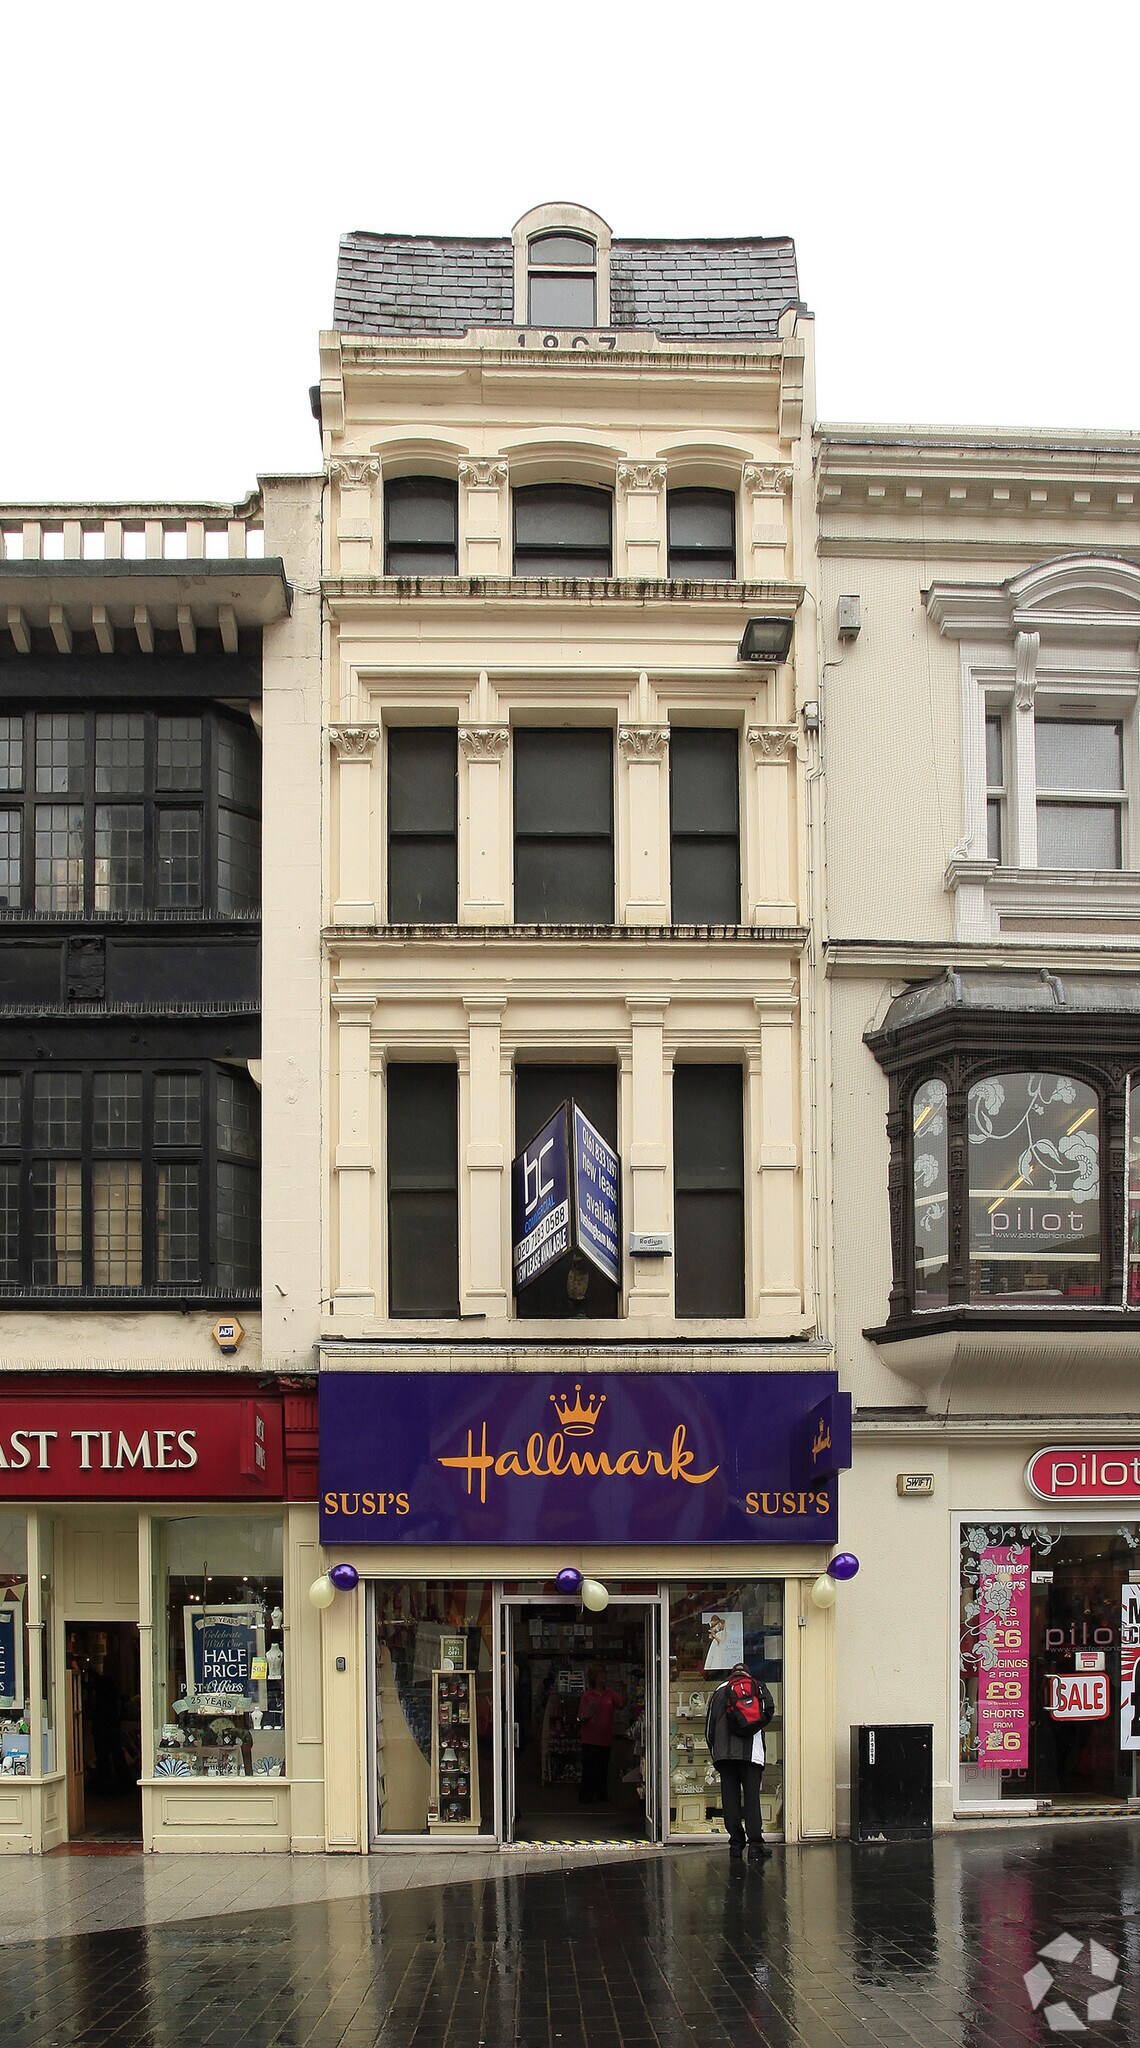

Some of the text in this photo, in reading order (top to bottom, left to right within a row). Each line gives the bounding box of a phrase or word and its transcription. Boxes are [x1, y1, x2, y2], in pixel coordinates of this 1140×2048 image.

[582, 1152, 597, 1183] new
[545, 1206, 565, 1235] 0588
[586, 1192, 617, 1238] available
[991, 1206, 1083, 1235] pilot
[219, 1327, 234, 1336] ADT
[71, 1430, 198, 1469] TIMES
[437, 1421, 719, 1503] Hallmark
[1051, 1454, 1140, 1493] pilot
[906, 1477, 932, 1488] SWIFT
[324, 1492, 410, 1515] SUSI'S
[745, 1492, 831, 1515] SUSI'S
[204, 1649, 247, 1663] HALF
[204, 1664, 248, 1678] PRICE
[191, 1696, 232, 1708] 25 YEARS
[986, 1681, 1022, 1700] £8
[1055, 1682, 1104, 1712] SALE
[982, 1709, 1025, 1718] SHORTS
